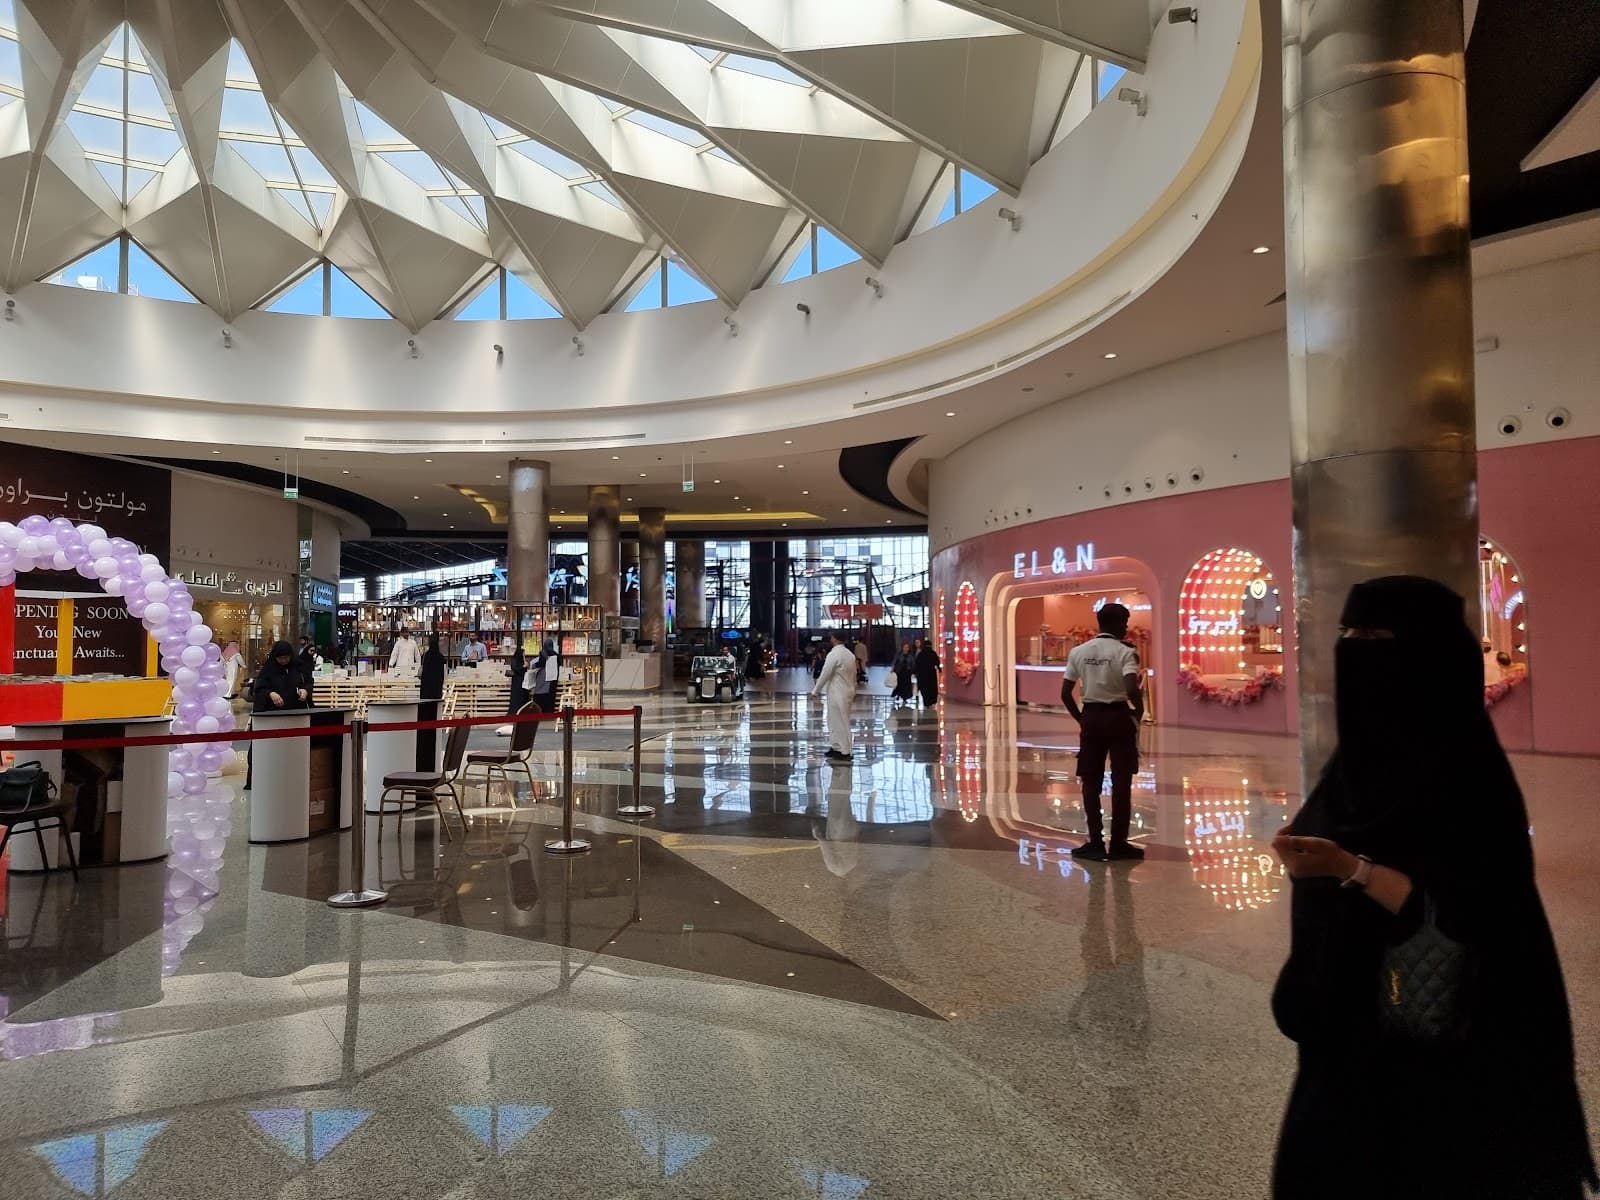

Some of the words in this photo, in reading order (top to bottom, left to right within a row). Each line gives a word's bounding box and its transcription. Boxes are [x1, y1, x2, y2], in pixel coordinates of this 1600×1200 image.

[77, 490, 147, 517] مولتون
[14, 604, 79, 619] PENIG
[87, 606, 129, 620] SOON
[34, 625, 59, 639] You
[73, 625, 102, 639] New
